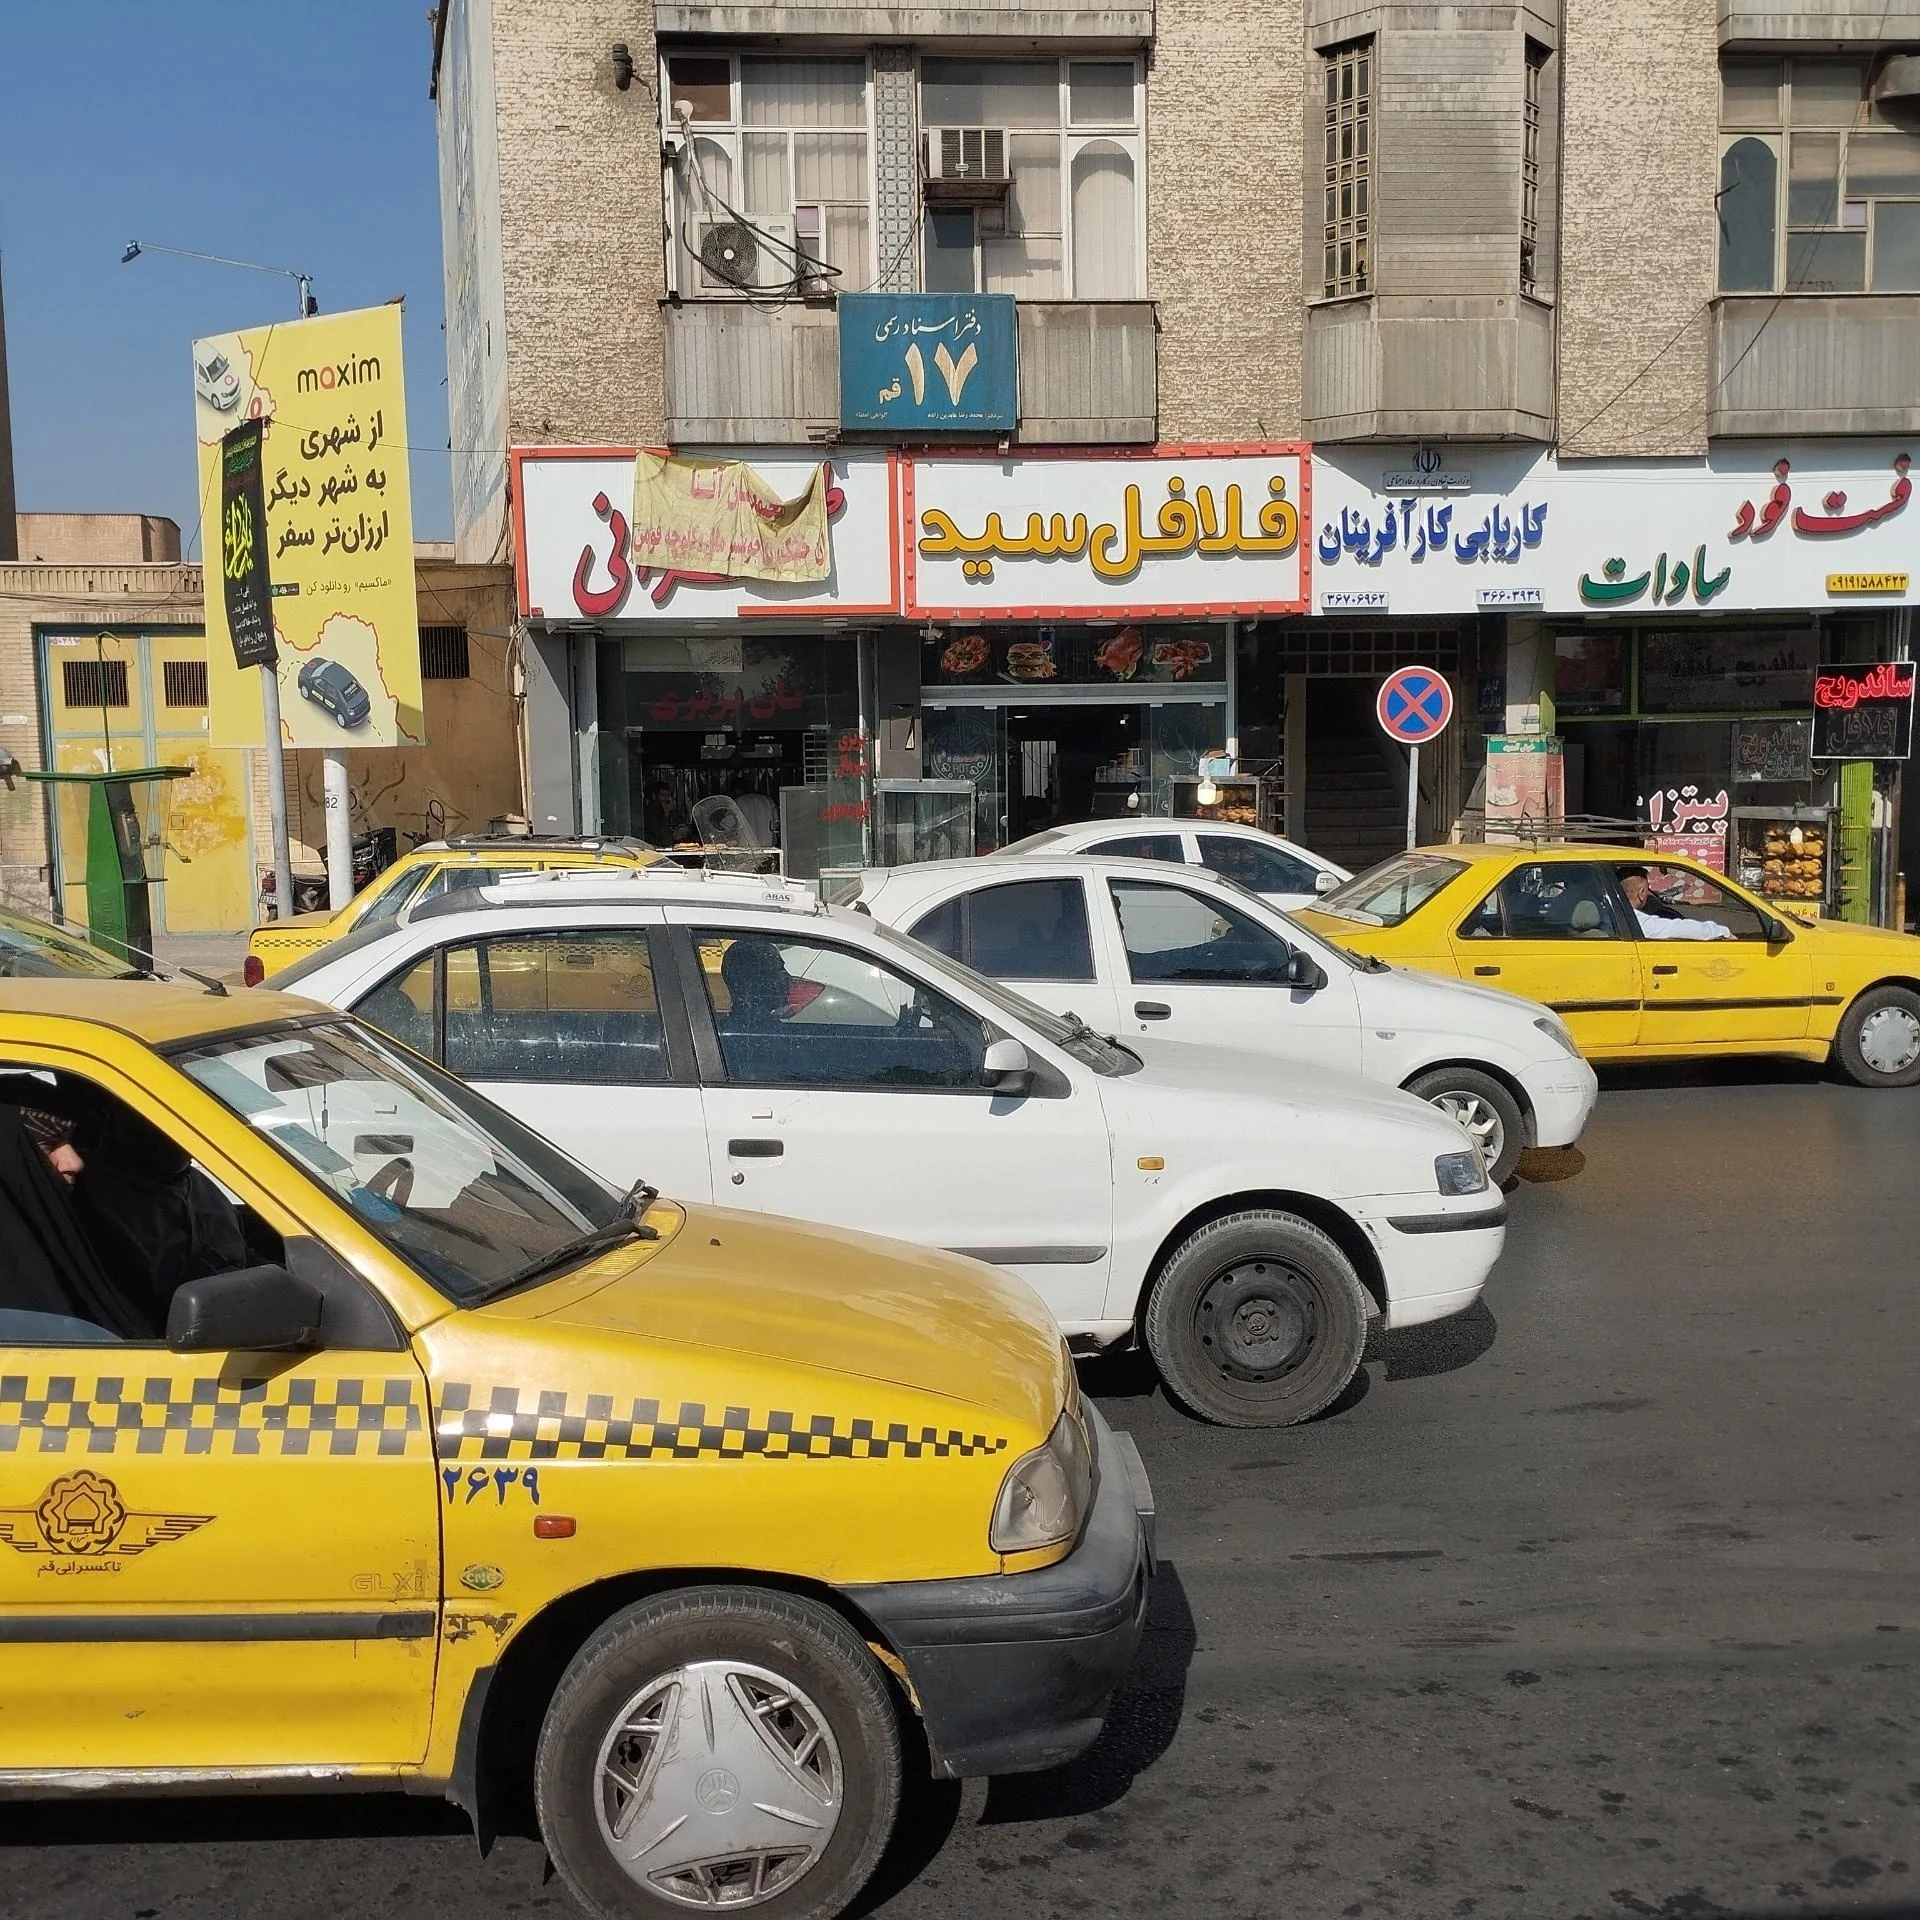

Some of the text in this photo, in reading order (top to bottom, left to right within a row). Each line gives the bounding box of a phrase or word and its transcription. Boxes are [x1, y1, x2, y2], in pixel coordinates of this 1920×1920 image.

[875, 308, 982, 342] دفتر اسناد رسمی
[297, 353, 381, 393] maxim
[879, 342, 978, 406] ۱۷ قم
[368, 409, 383, 452] از
[927, 411, 939, 420] زاده
[940, 411, 958, 420] عابدین
[958, 411, 968, 420] رضا
[968, 411, 984, 419] محمد
[301, 413, 361, 460] شهری
[267, 463, 386, 512] به شهر دیگر
[1387, 475, 1405, 487] اجتماعی
[1447, 475, 1470, 485] وزارت
[1729, 453, 1913, 538] فست فود
[276, 520, 315, 559] سفر
[918, 508, 1088, 577] سید
[1089, 475, 1299, 577] فلافل
[1454, 501, 1548, 562] کاریابی
[306, 581, 318, 596] کن
[320, 580, 342, 594] دانلود
[343, 582, 351, 594] رو
[355, 576, 392, 593] «ماکسیم»
[1582, 544, 1732, 600] سادات
[1327, 593, 1385, 606] ۳۶۷۰۶۹۶۲
[1482, 590, 1541, 603] ۳۶۶۰۳۹۳۹
[1815, 665, 1912, 708] ساندویچ
[1830, 709, 1892, 750] فلافل
[1649, 785, 1729, 836] پیتزا
[442, 1465, 540, 1505] ۲۶۳۹
[37, 1560, 122, 1577] تاکسیرانی قم
[351, 1568, 423, 1593] GLXi
[465, 1567, 498, 1583] CNG
